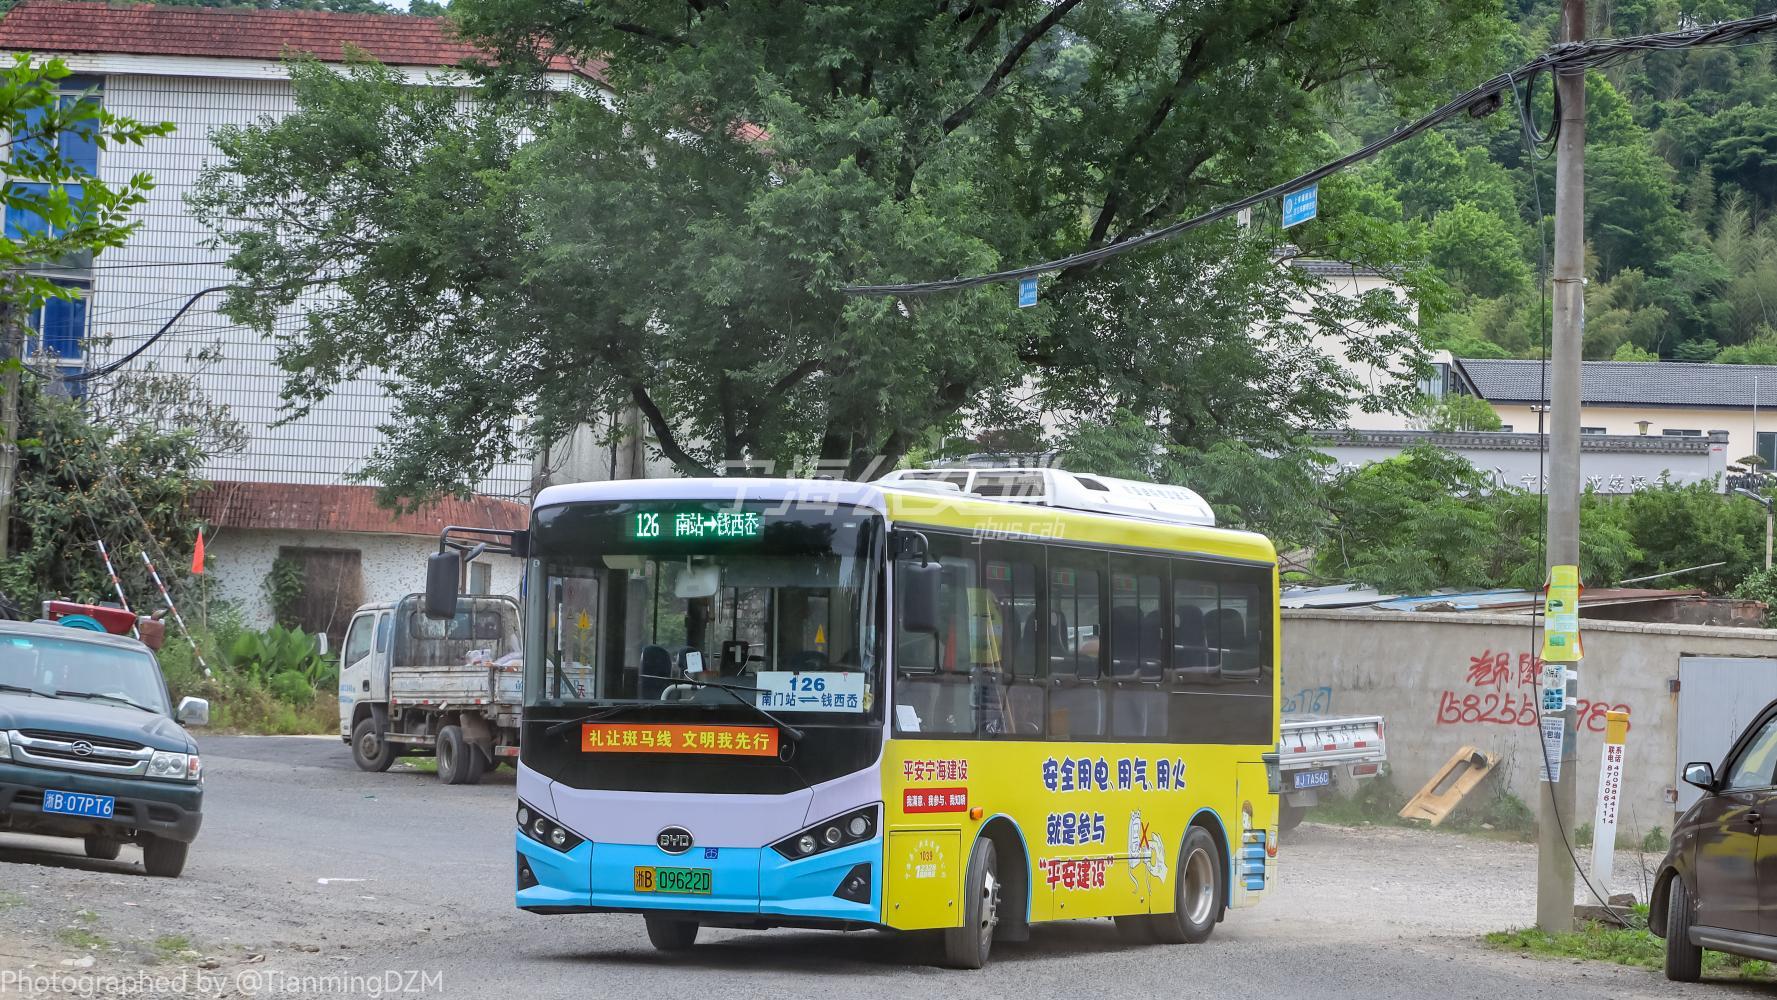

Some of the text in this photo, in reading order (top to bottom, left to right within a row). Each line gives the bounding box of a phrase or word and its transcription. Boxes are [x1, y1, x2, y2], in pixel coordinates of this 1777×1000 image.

[636, 513, 660, 537] 126
[789, 677, 826, 692] 126
[589, 729, 770, 751] 礼让斑马线 文明我先行
[903, 760, 968, 781] 平安宁海建设
[1042, 757, 1187, 793] 安全用电、用气、用火
[1046, 812, 1106, 845] 就是参与
[660, 834, 690, 847] BYD
